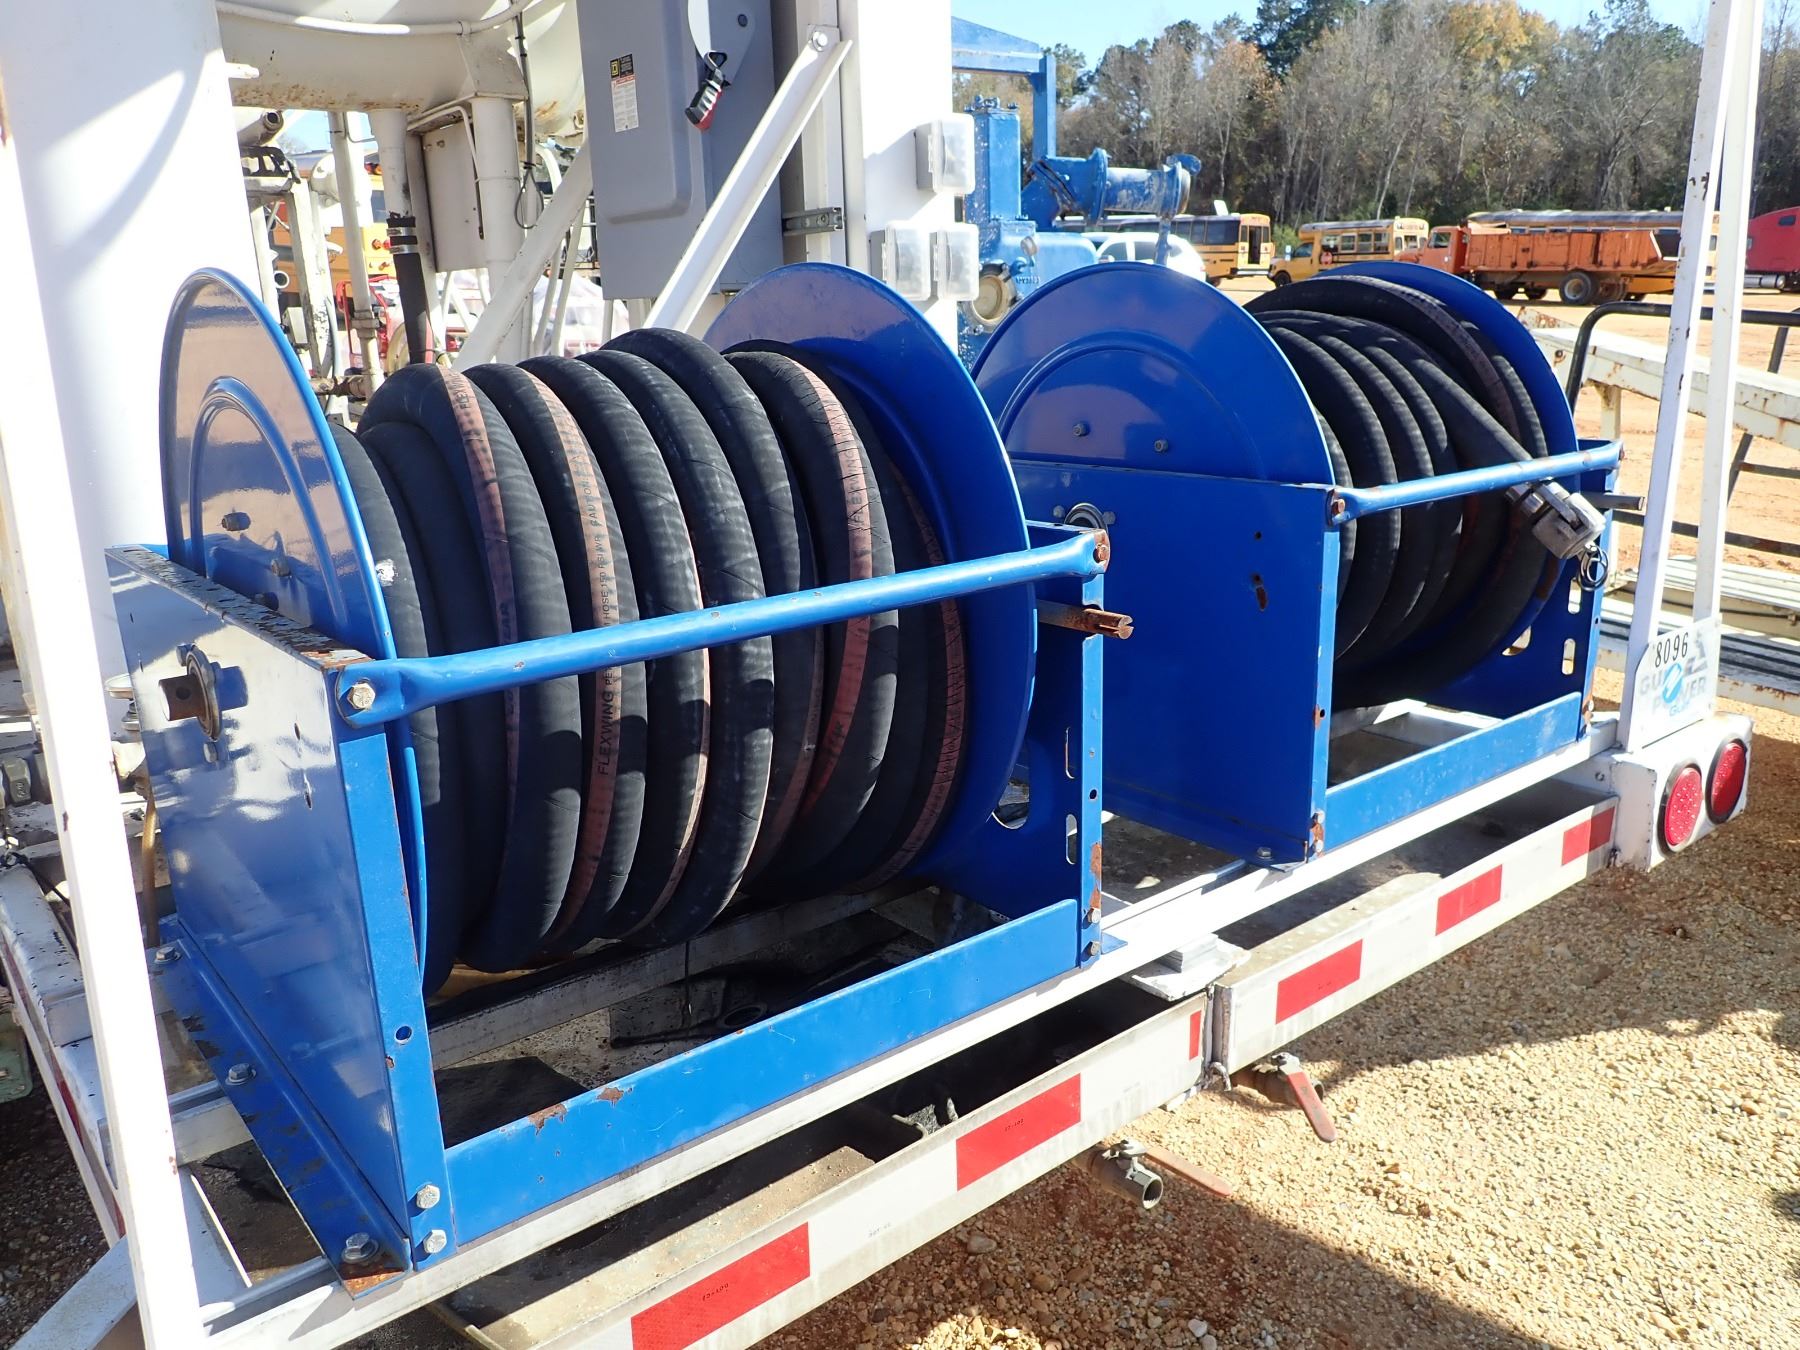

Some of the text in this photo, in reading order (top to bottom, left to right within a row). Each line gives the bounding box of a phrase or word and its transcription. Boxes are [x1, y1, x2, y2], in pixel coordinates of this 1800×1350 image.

[600, 591, 610, 619] HOSE
[1655, 632, 1689, 668] 8096
[597, 691, 614, 775] FLEXWING
